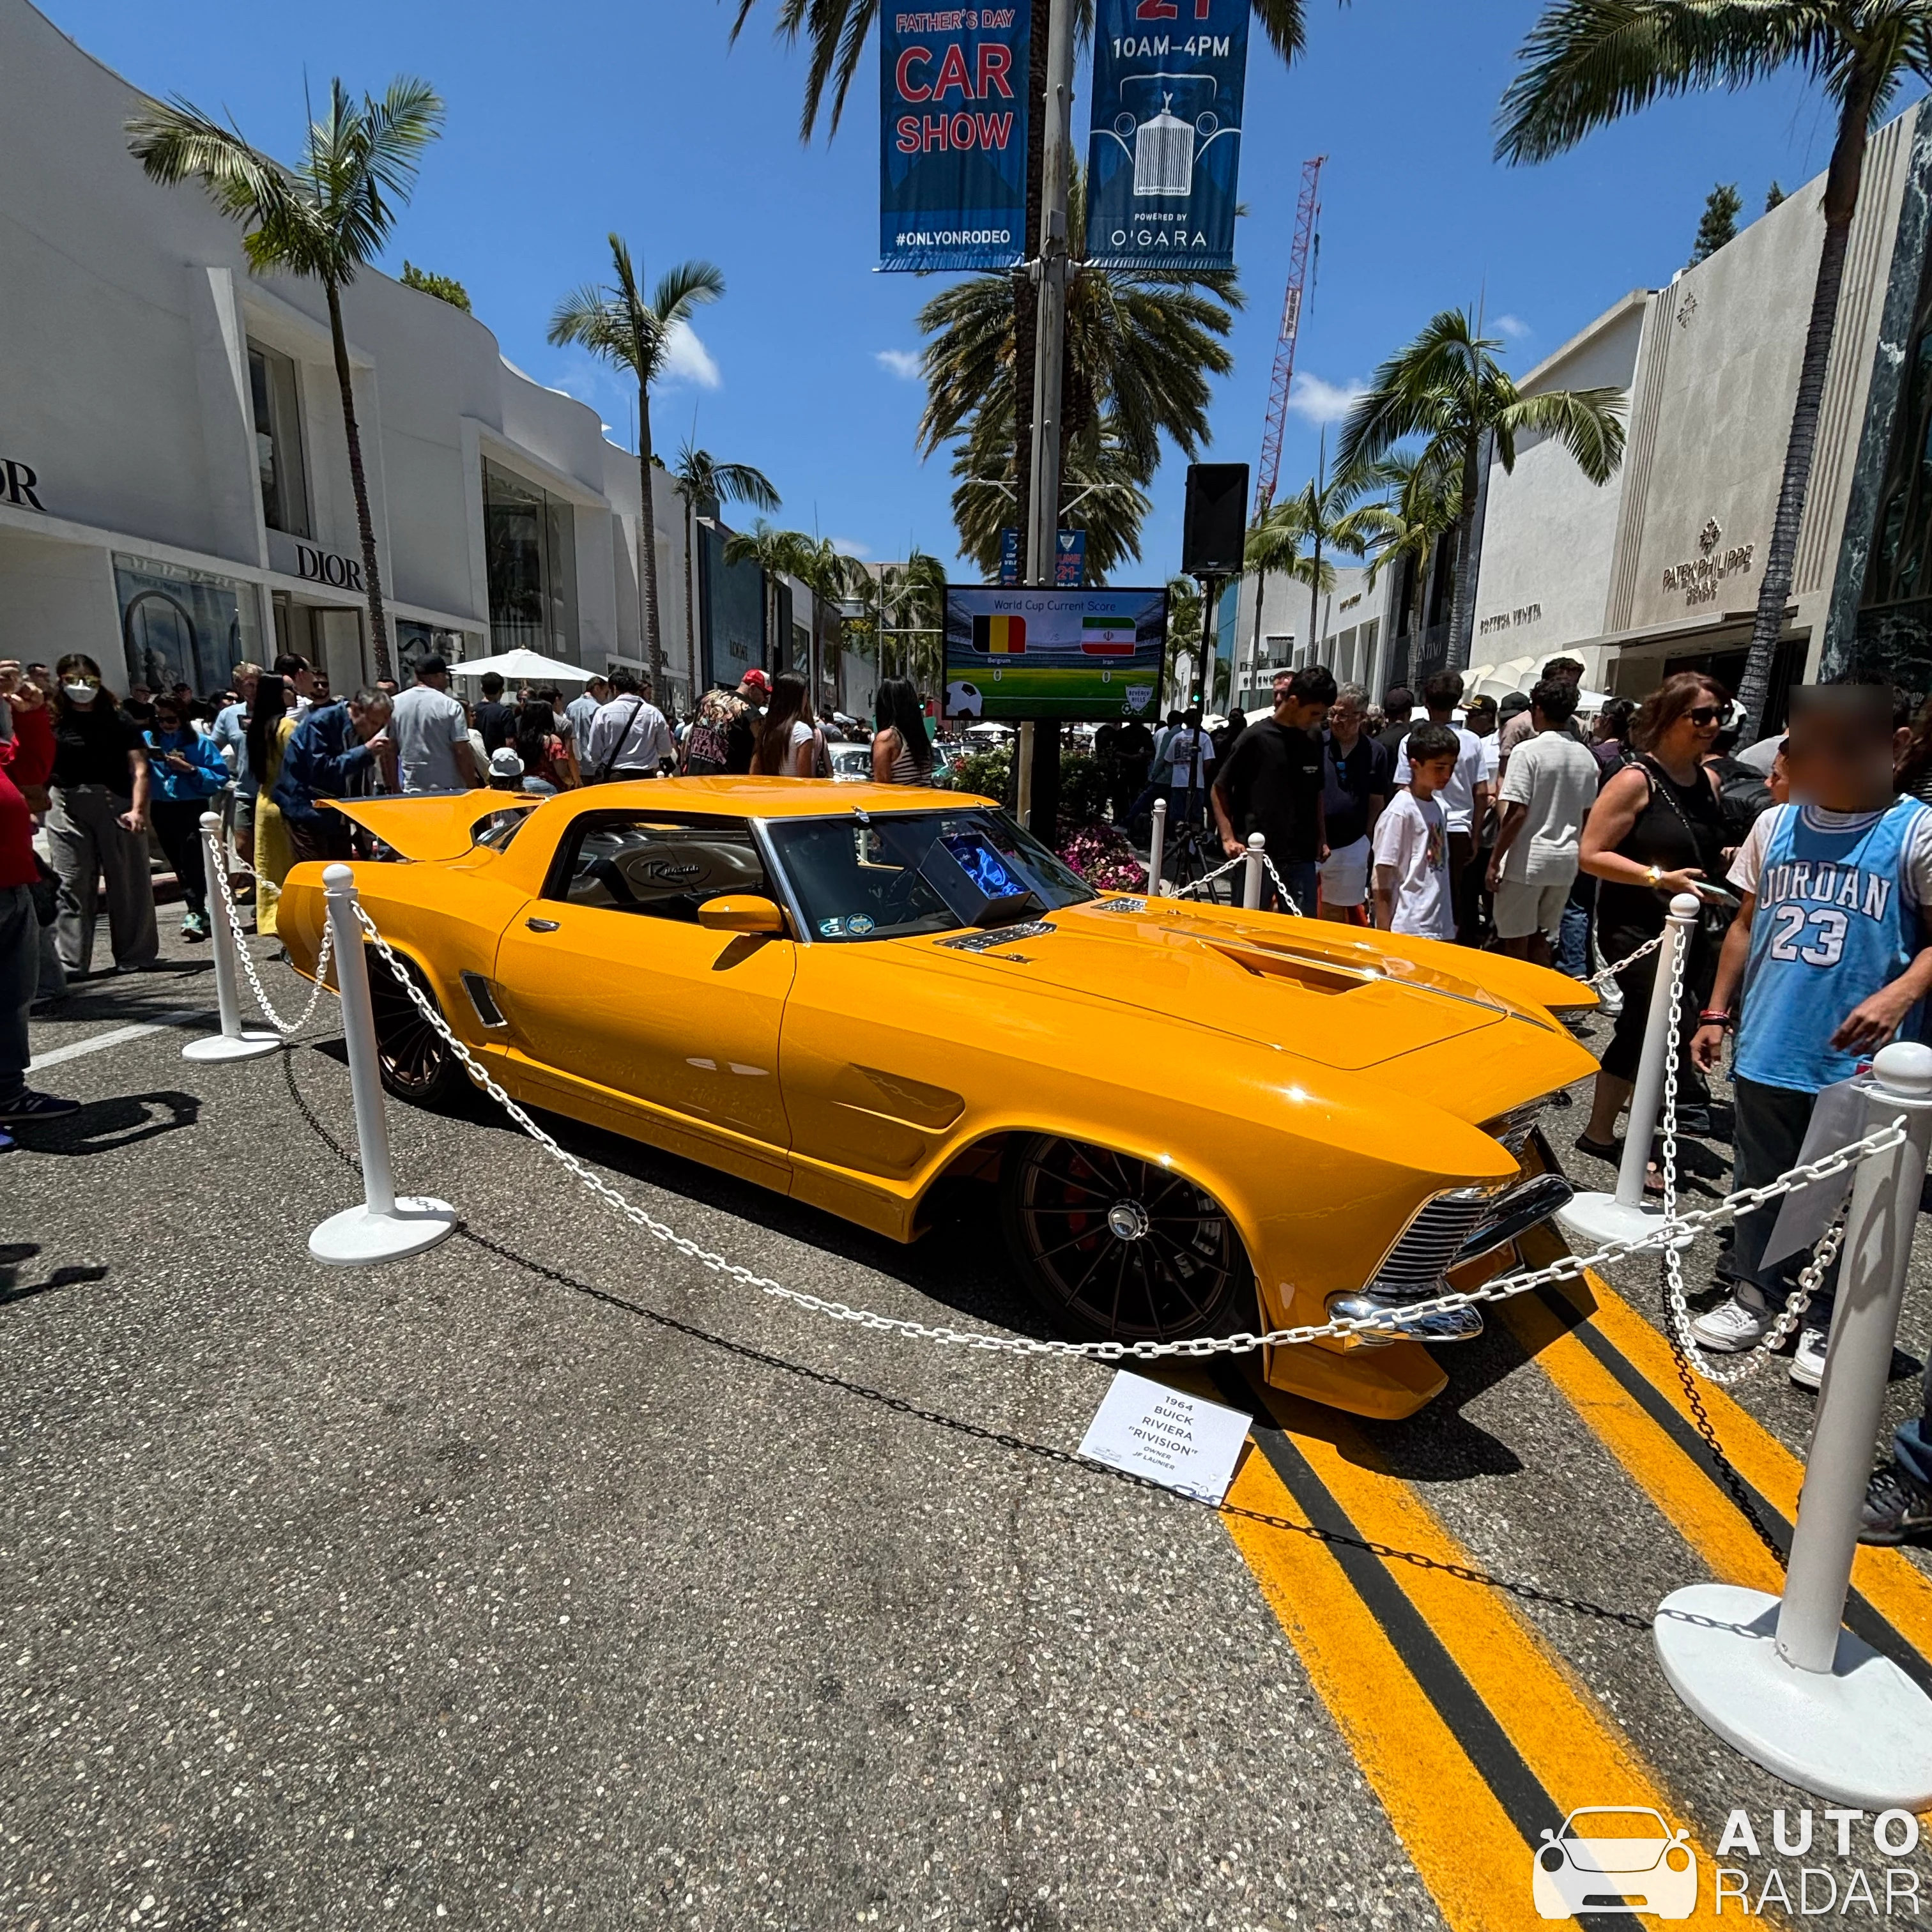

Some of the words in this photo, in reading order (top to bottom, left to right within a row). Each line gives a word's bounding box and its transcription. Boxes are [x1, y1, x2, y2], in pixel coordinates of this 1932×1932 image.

[896, 9, 978, 33] FATHER'S
[981, 9, 1016, 28] DAY
[896, 43, 1015, 103] CAR
[896, 112, 1013, 153] SHOW
[1134, 212, 1174, 221] POWERED
[1176, 213, 1187, 221] BY
[896, 229, 1011, 246] #ONLYONRODEO
[1111, 229, 1207, 247] O'GARA
[295, 544, 365, 592] DIOR
[1056, 566, 1075, 580] 21
[1662, 559, 1698, 589] PATEK
[1698, 543, 1755, 576] PHILIPPE
[994, 600, 1022, 610] World
[1025, 600, 1044, 613] Cup
[1047, 601, 1084, 611] Current
[1087, 601, 1116, 611] Score
[993, 669, 1002, 682] 0
[1101, 671, 1111, 683] 0
[1761, 861, 1891, 923] JORDAN
[1770, 904, 1850, 968] 23
[1166, 1395, 1193, 1411] 1964
[1154, 1406, 1194, 1426] BUICK
[1142, 1416, 1192, 1442] RIVIERA
[1128, 1425, 1199, 1456] "RIVISION"
[1142, 1454, 1176, 1470] LAUNIER
[1143, 1446, 1172, 1460] OWNER
